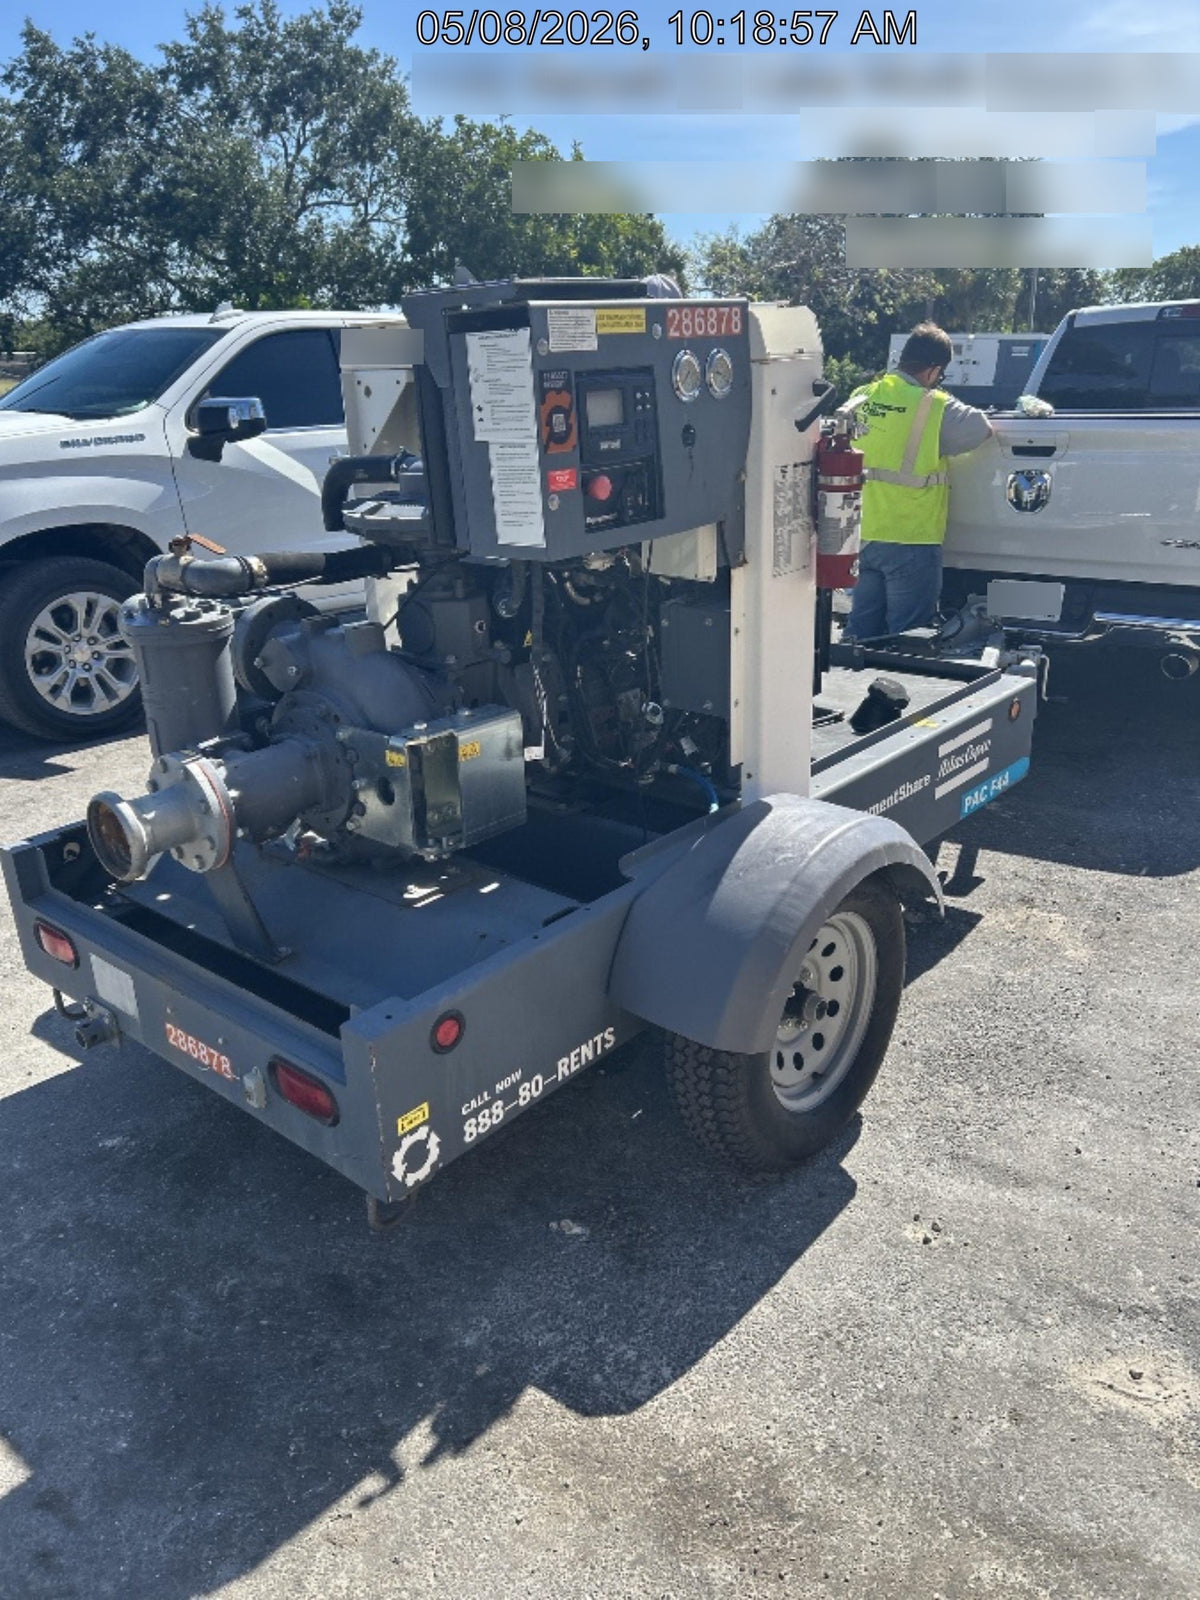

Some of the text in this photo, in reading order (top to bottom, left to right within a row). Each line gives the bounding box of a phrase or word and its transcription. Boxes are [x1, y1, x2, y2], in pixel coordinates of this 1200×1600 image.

[667, 307, 741, 336] 286878
[866, 774, 931, 816] mentShare
[964, 785, 988, 813] PAC
[165, 1022, 232, 1078] 286878
[461, 1068, 522, 1115] CALL NOW
